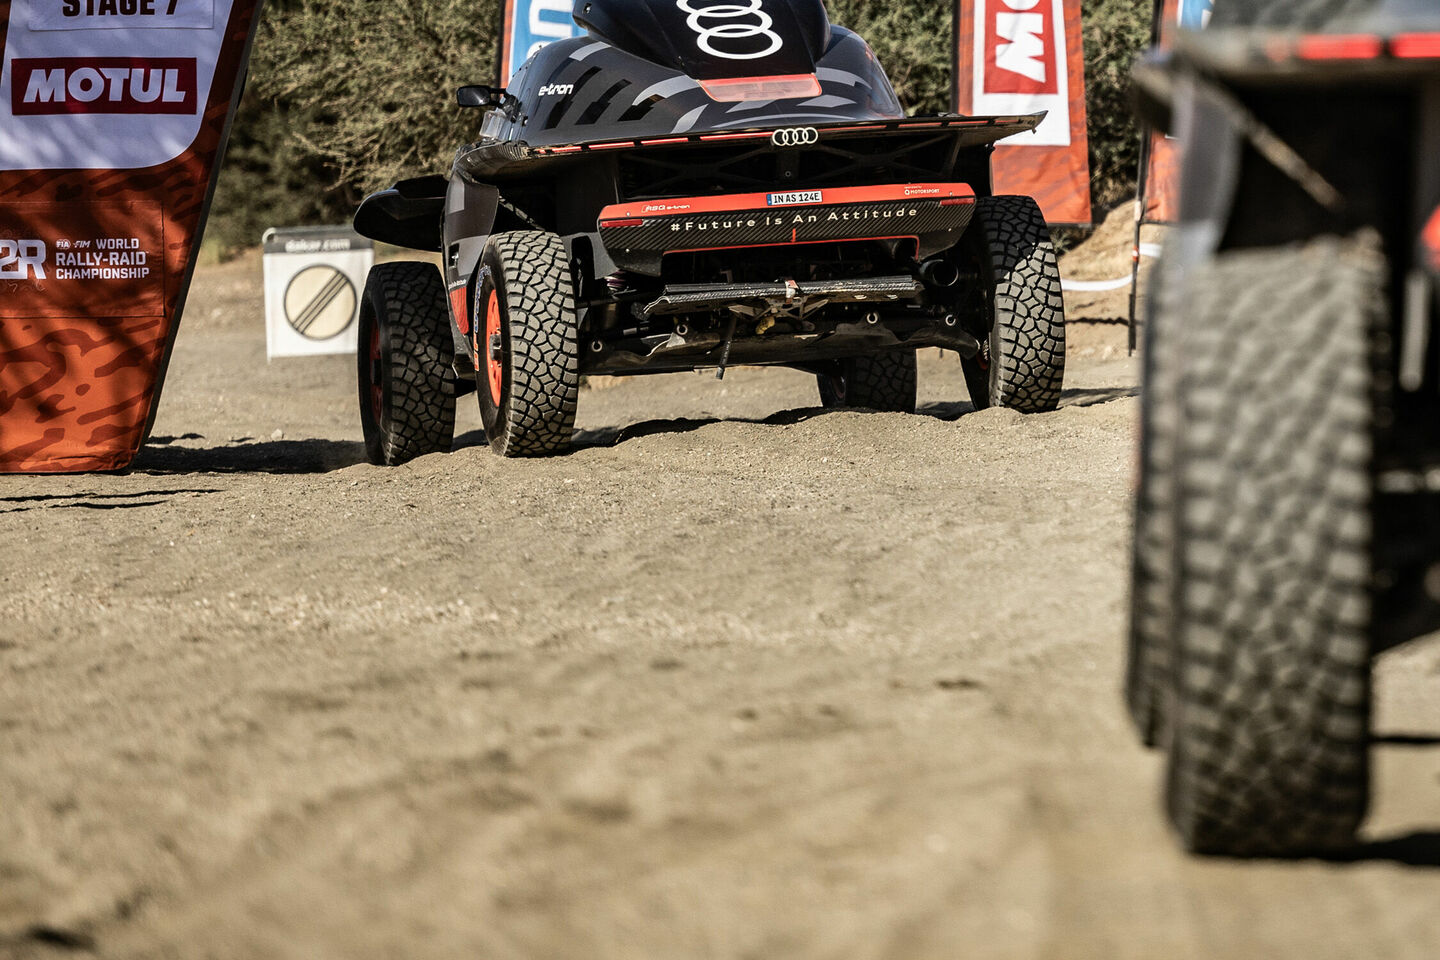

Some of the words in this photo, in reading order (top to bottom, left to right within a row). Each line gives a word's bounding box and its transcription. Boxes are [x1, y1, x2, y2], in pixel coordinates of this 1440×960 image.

[23, 67, 186, 103] MOTUL
[538, 83, 574, 96] e-tron
[774, 195, 784, 203] IN
[786, 193, 796, 203] AS
[799, 192, 820, 202] 124E
[671, 219, 755, 232] #Future
[766, 216, 782, 226] Is
[793, 214, 817, 224] An
[827, 208, 917, 221] Attitude
[56, 239, 70, 249] FIA
[96, 238, 139, 250] WORLD
[56, 251, 146, 267] RALLY-RAID
[56, 267, 149, 279] CHAMPIONSHIP
